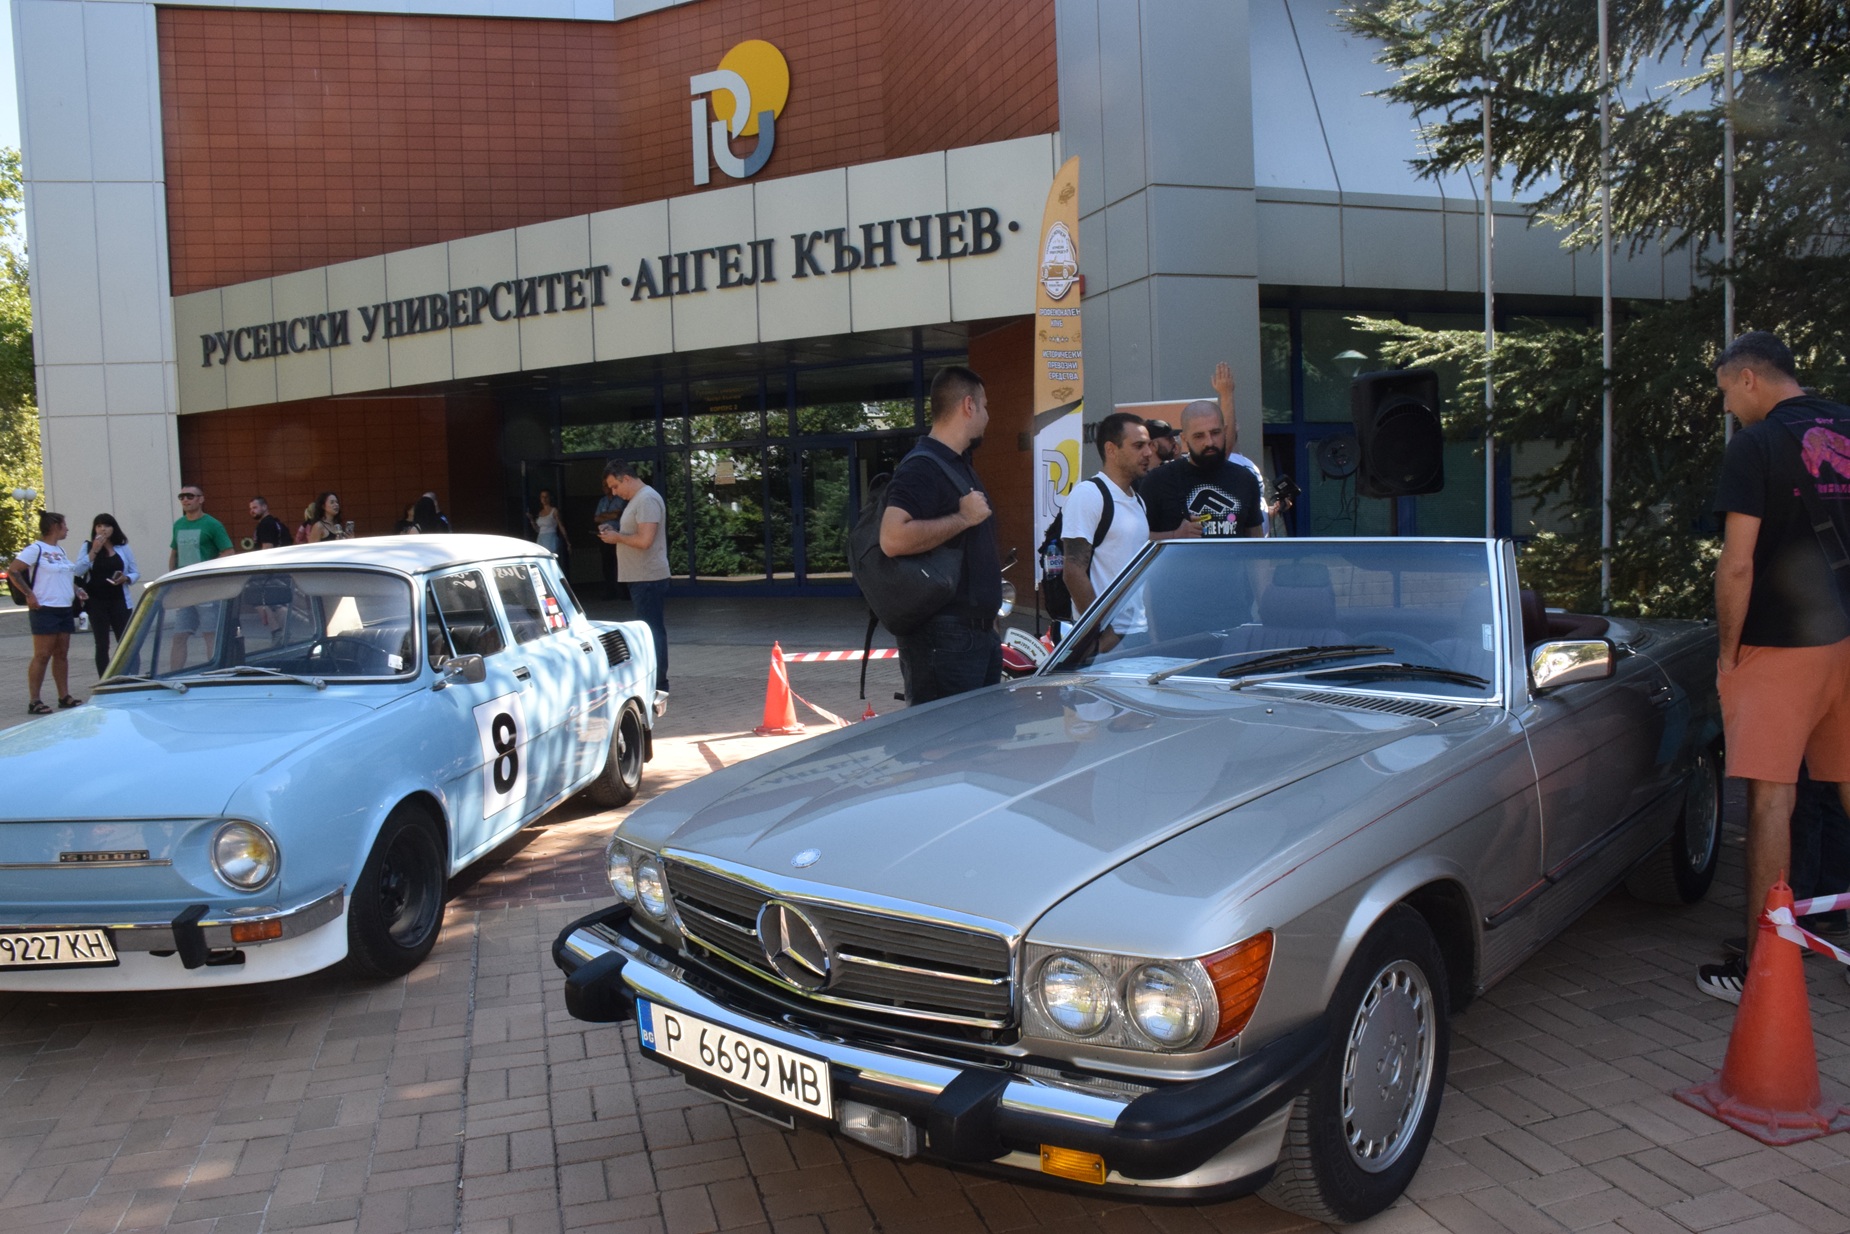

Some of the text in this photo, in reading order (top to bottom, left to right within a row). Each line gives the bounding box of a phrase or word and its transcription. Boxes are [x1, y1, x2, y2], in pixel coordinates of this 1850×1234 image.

[200, 309, 350, 368] РУСЕНСКИ
[357, 264, 610, 344] УНИВЕРСИТЕТ
[1042, 350, 1082, 359] ИСТОРИЧЕСКИ
[1047, 361, 1078, 370] ПРЕВОЗНИ
[1048, 371, 1079, 381] СРЕДСТВА
[492, 712, 519, 795] 8
[0, 933, 62, 961] 9227
[642, 1028, 655, 1044] BG
[664, 1014, 821, 1107] P 6699 MB
